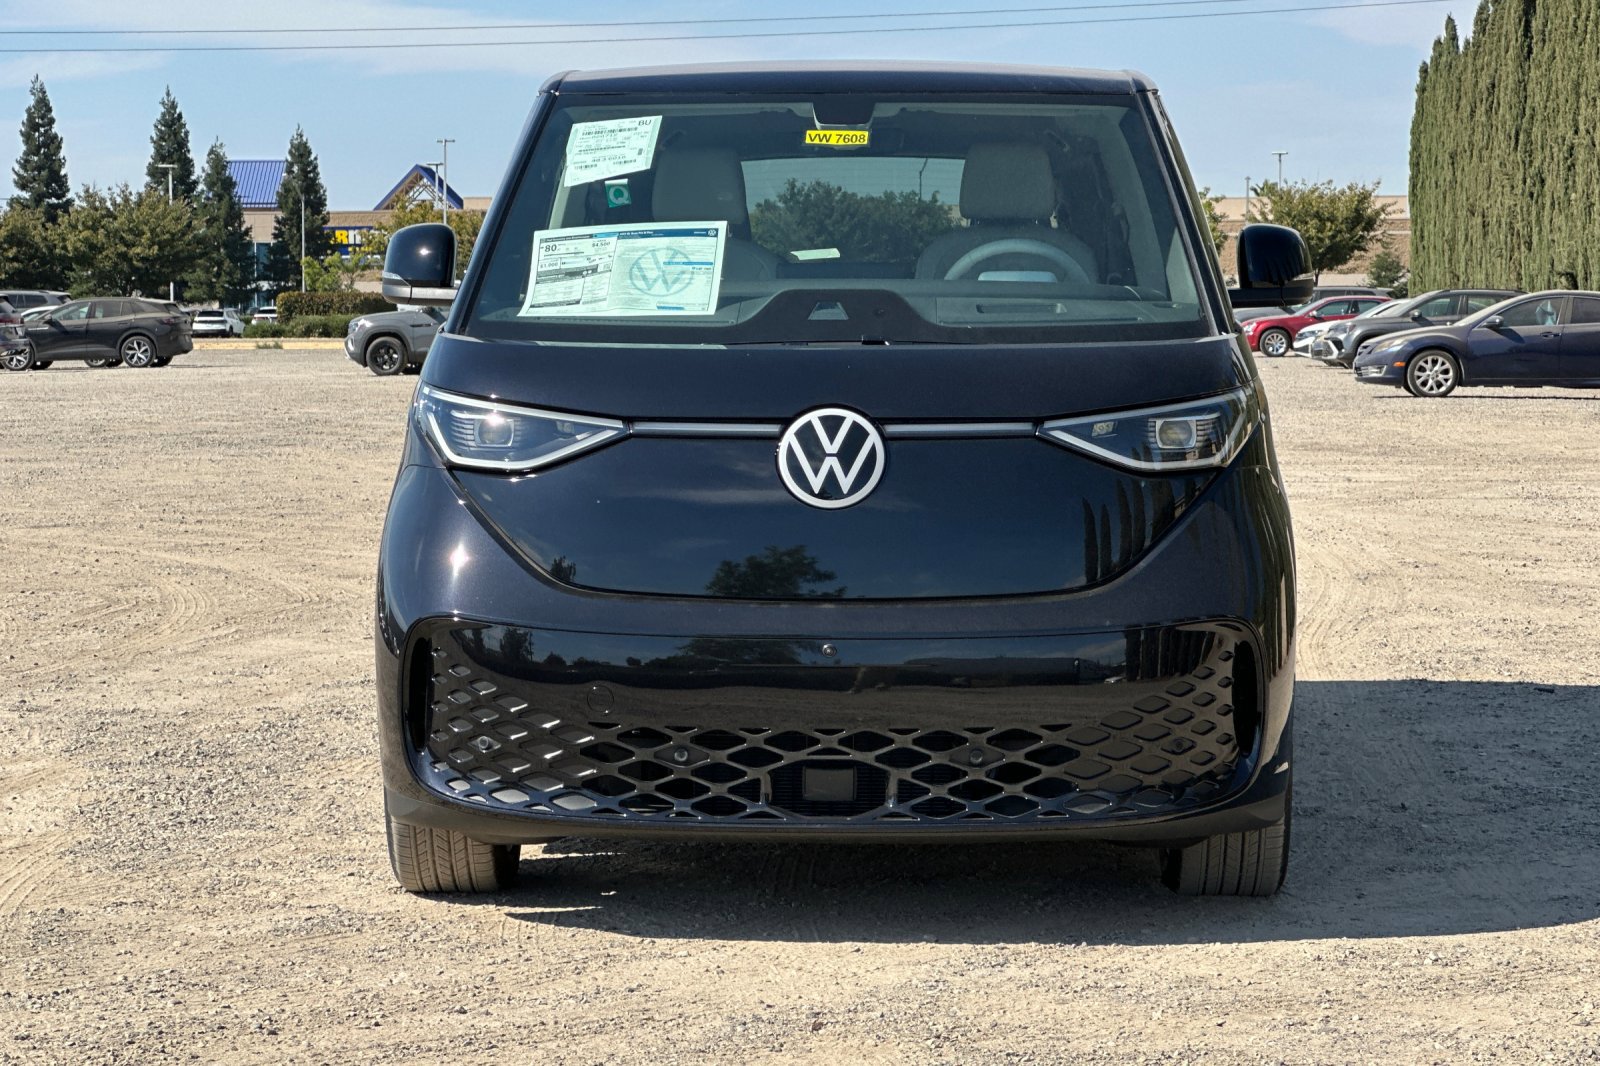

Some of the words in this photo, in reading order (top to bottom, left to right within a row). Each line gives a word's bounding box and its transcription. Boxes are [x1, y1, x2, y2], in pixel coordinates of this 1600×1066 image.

[808, 133, 832, 143] VW
[835, 133, 866, 144] 7608
[544, 244, 557, 252] 80
[782, 409, 882, 505] VW
